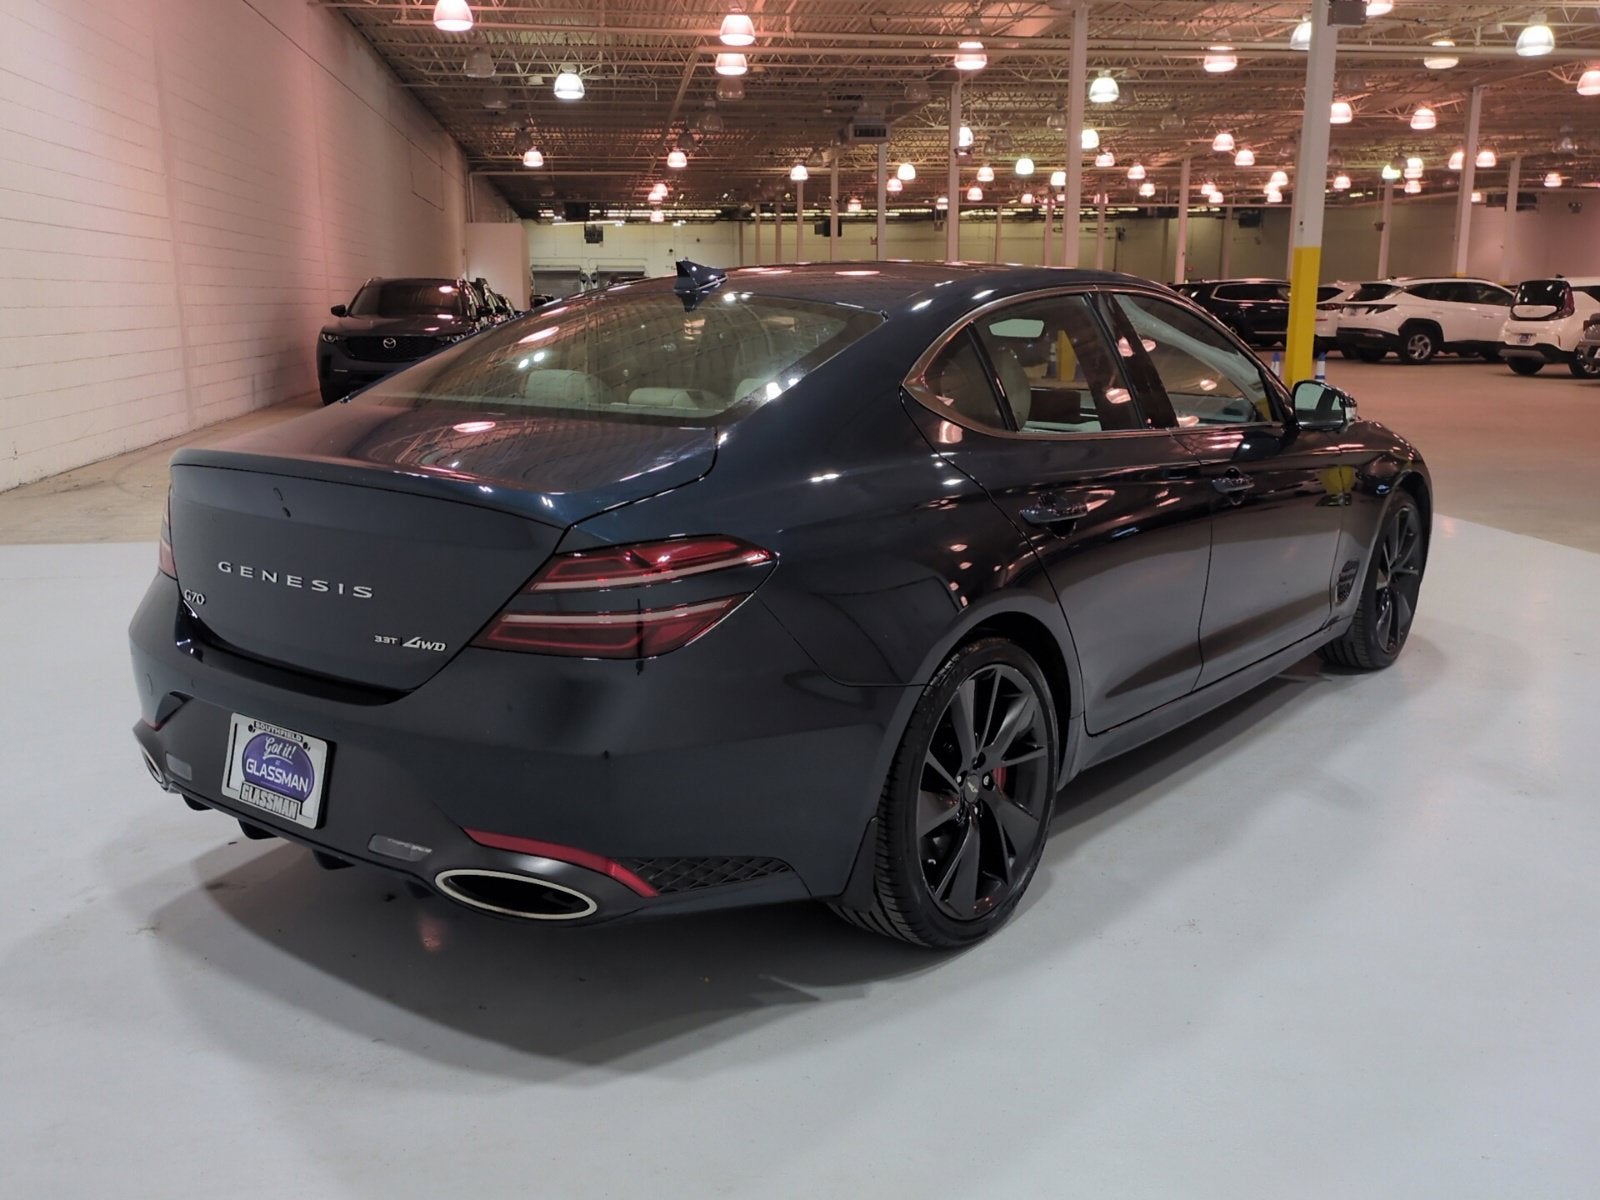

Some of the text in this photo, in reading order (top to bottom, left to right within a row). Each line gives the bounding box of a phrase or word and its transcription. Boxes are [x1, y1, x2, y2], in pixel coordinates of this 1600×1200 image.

[218, 561, 373, 599] GENESIS
[184, 589, 205, 606] G70
[402, 636, 446, 652] 4WD
[255, 721, 302, 741] SOUTHFIELD
[264, 736, 296, 759] Got it!
[246, 758, 309, 793] GLASSMAN
[241, 784, 297, 819] GLASSMAN
